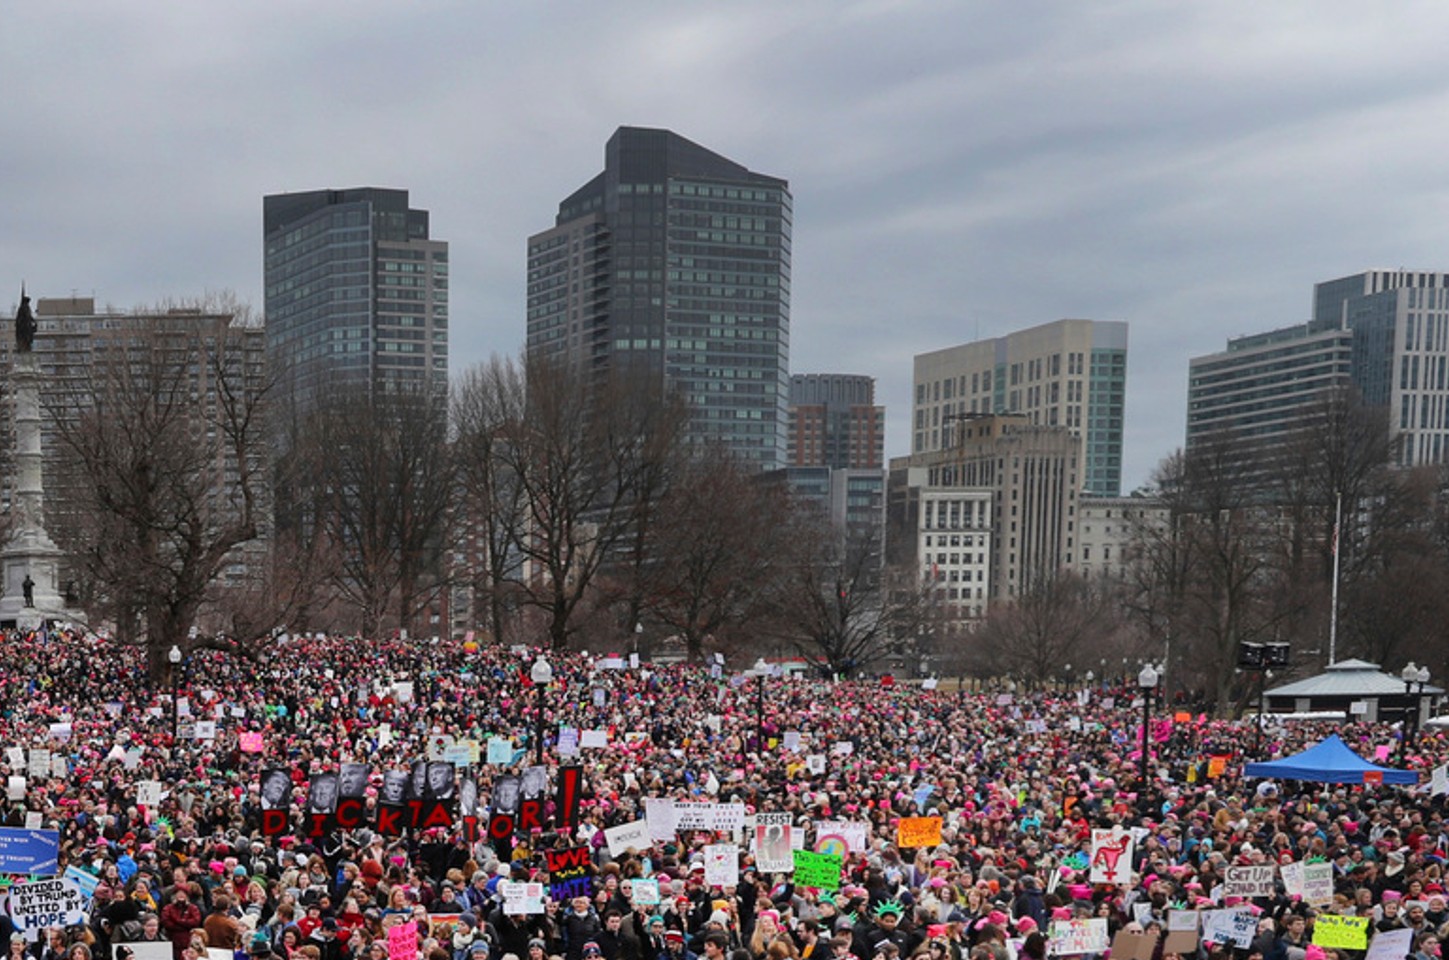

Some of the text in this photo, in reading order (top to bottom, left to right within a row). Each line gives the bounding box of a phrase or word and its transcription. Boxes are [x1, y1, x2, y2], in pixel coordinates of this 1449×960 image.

[757, 814, 790, 825] RESIST
[13, 881, 64, 896] DIVIDED
[551, 876, 593, 903] HATE
[20, 890, 78, 906] BY TRUMP
[13, 900, 81, 916] UNITED BY
[24, 912, 68, 930] HOPE
